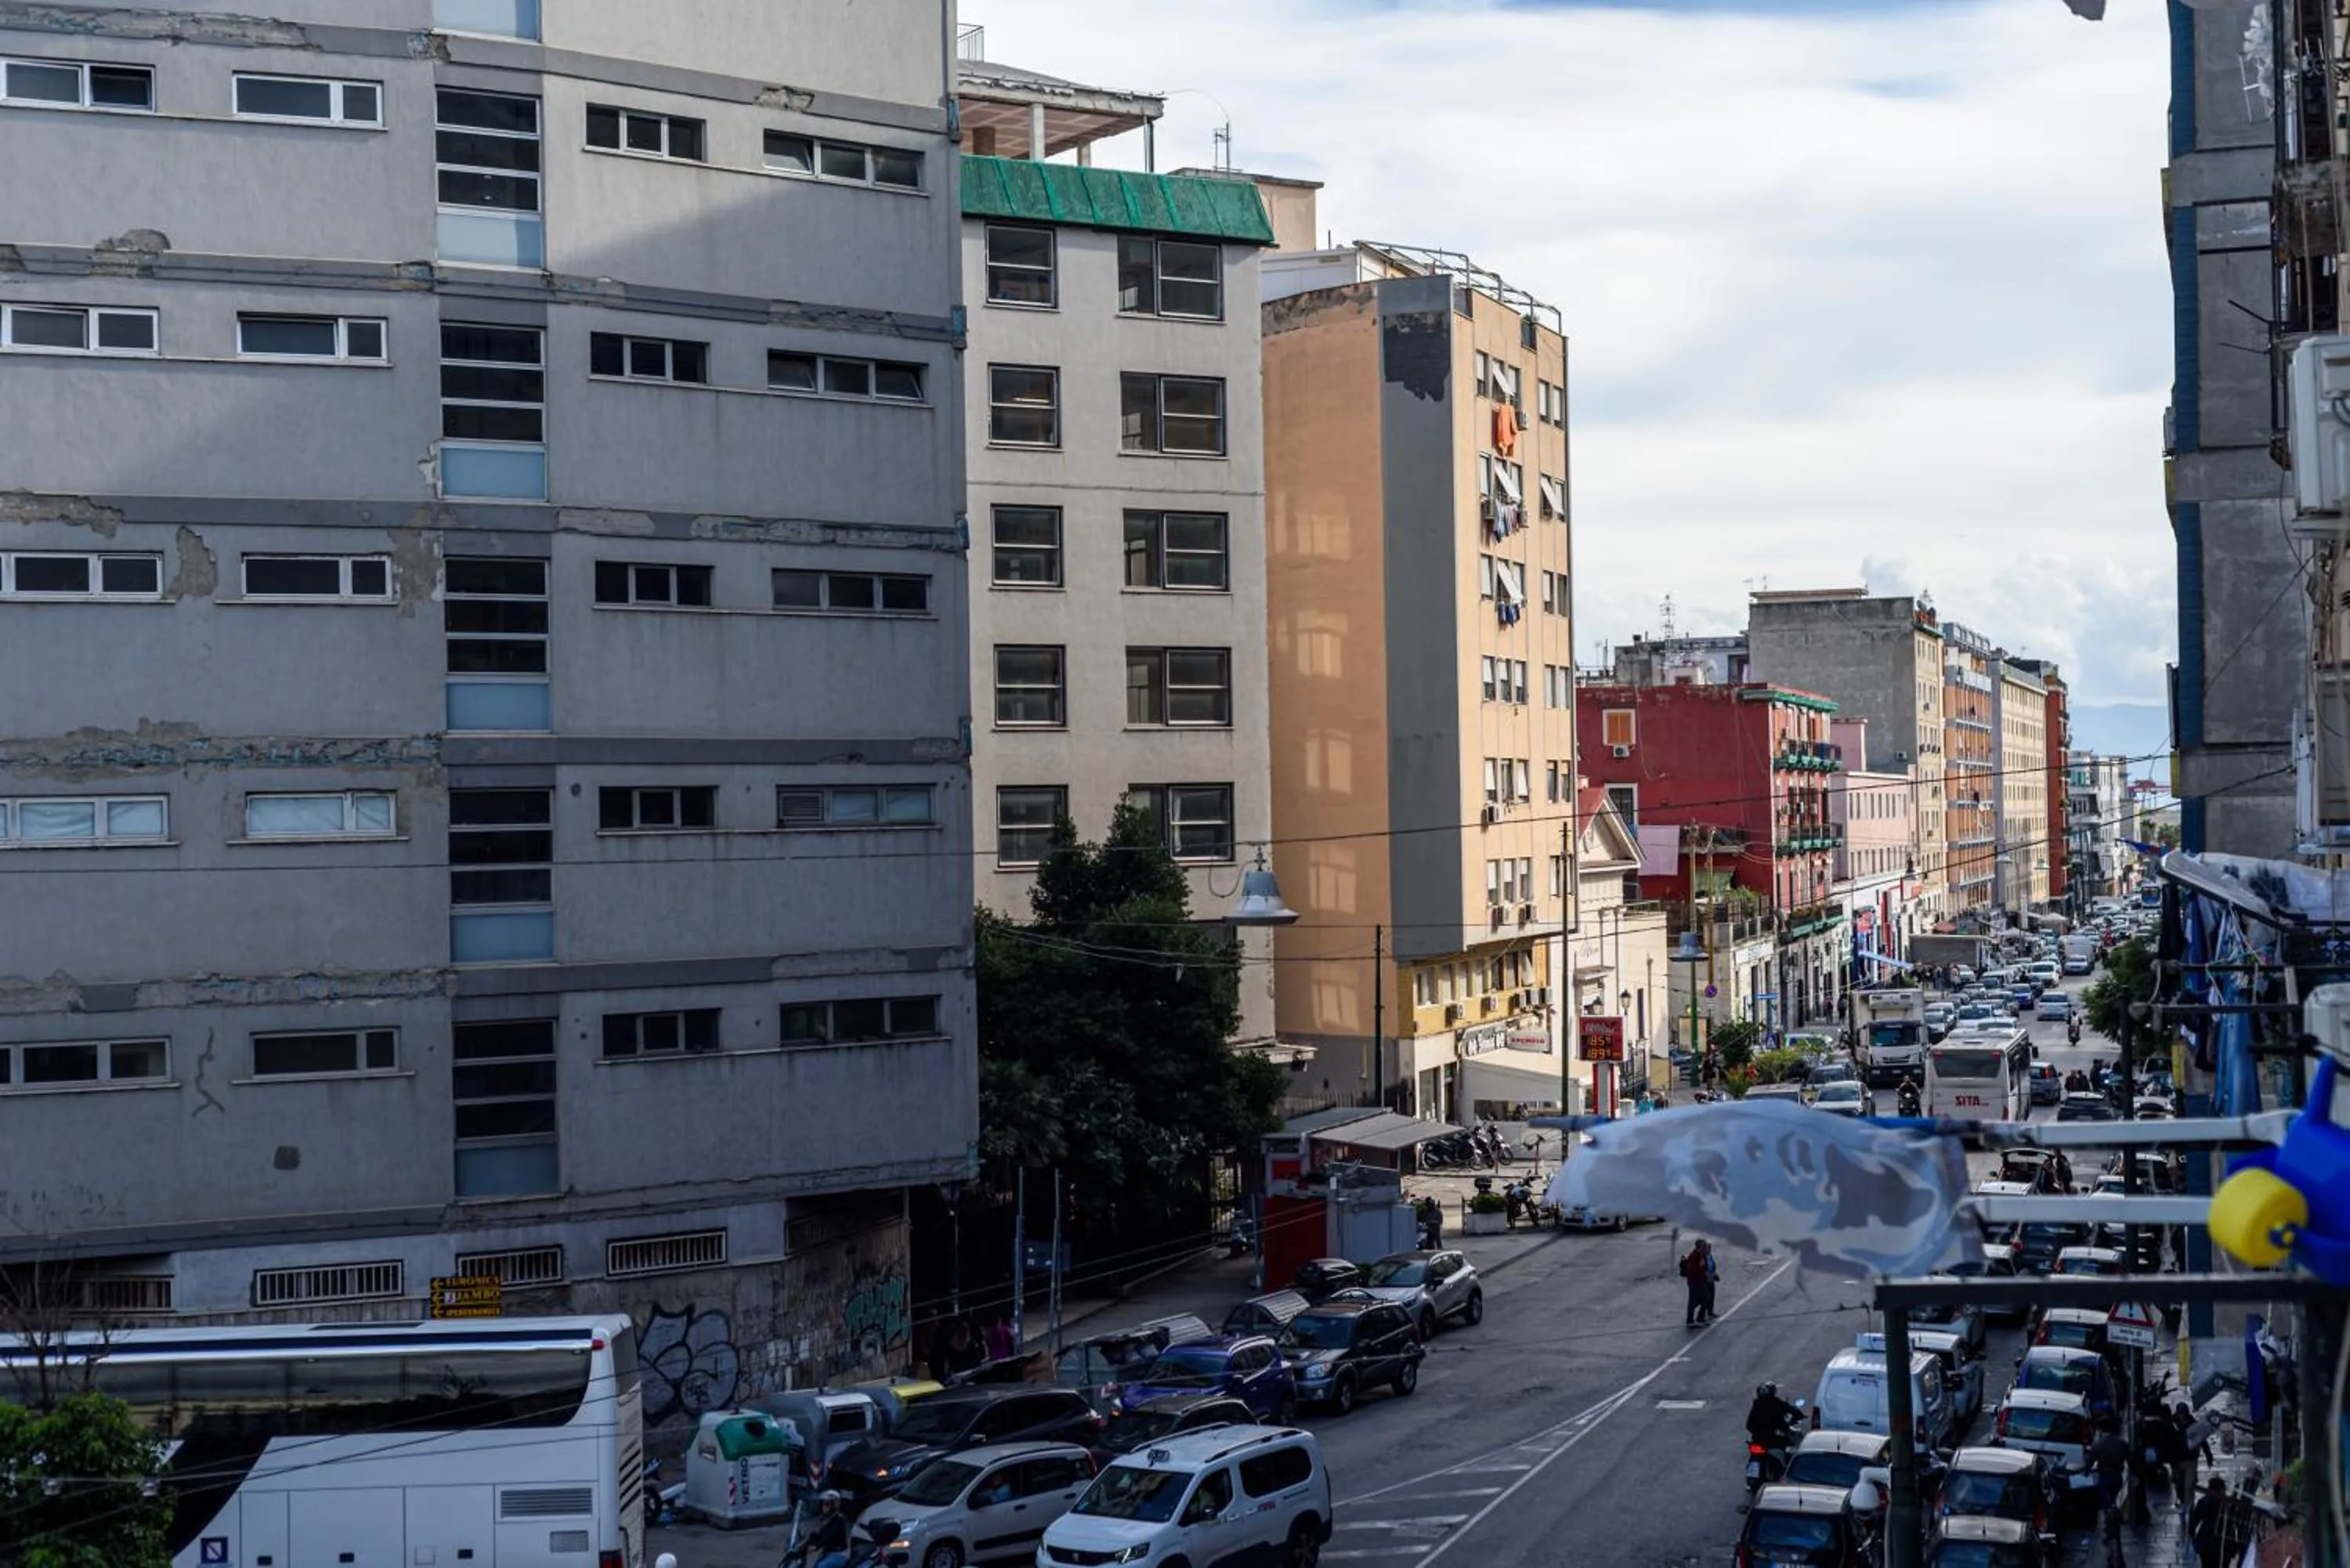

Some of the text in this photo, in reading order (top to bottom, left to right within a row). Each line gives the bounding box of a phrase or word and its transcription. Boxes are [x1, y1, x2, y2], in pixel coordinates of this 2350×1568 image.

[1954, 1096, 1980, 1107] SITA
[446, 1276, 501, 1287] EURONICS
[457, 1288, 501, 1302] JAMBO
[740, 1458, 750, 1504] VETRO
